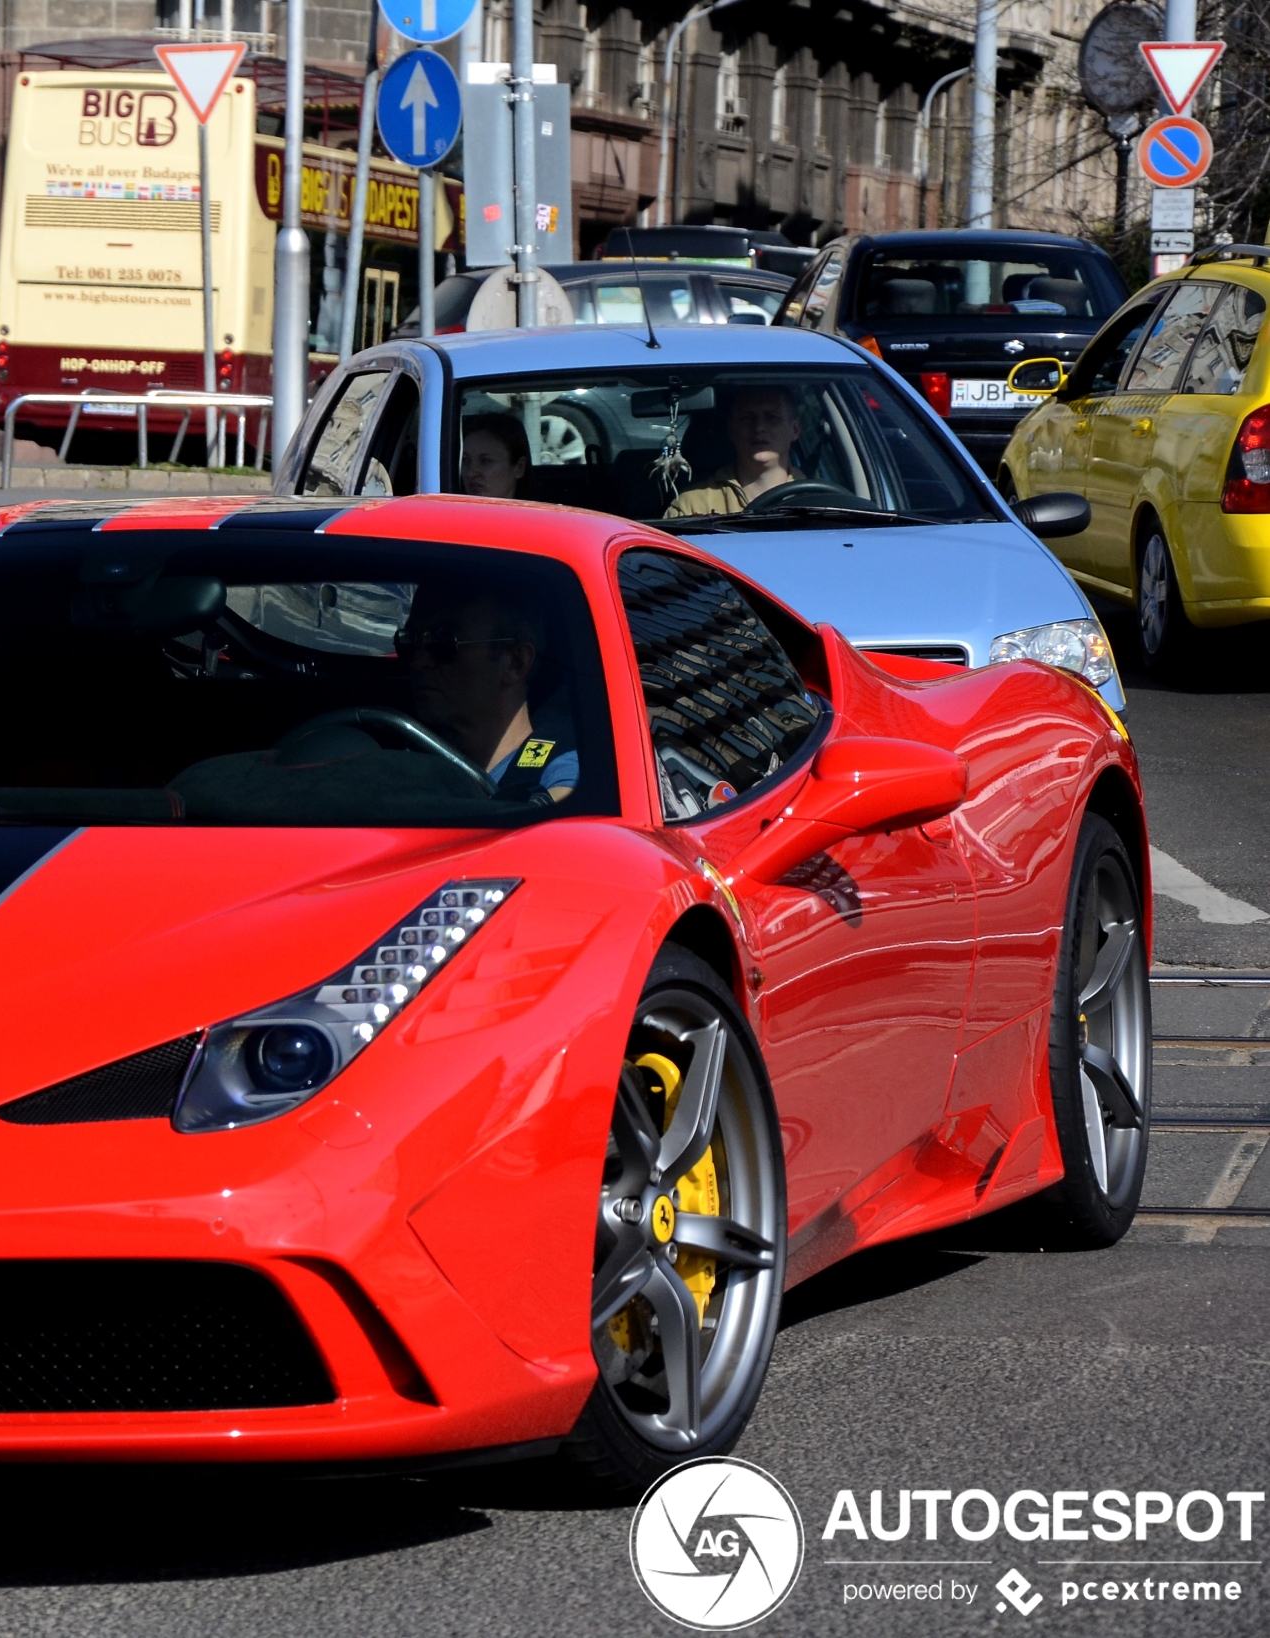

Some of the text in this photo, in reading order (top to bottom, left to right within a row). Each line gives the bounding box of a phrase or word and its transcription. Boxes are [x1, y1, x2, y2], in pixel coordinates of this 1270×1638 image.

[82, 89, 134, 118] BIG
[79, 120, 132, 146] BUS
[46, 163, 200, 181] We're all over Budapes
[56, 265, 182, 282] Tel: 061 235 0078
[43, 290, 191, 306] www.bigbustours.com
